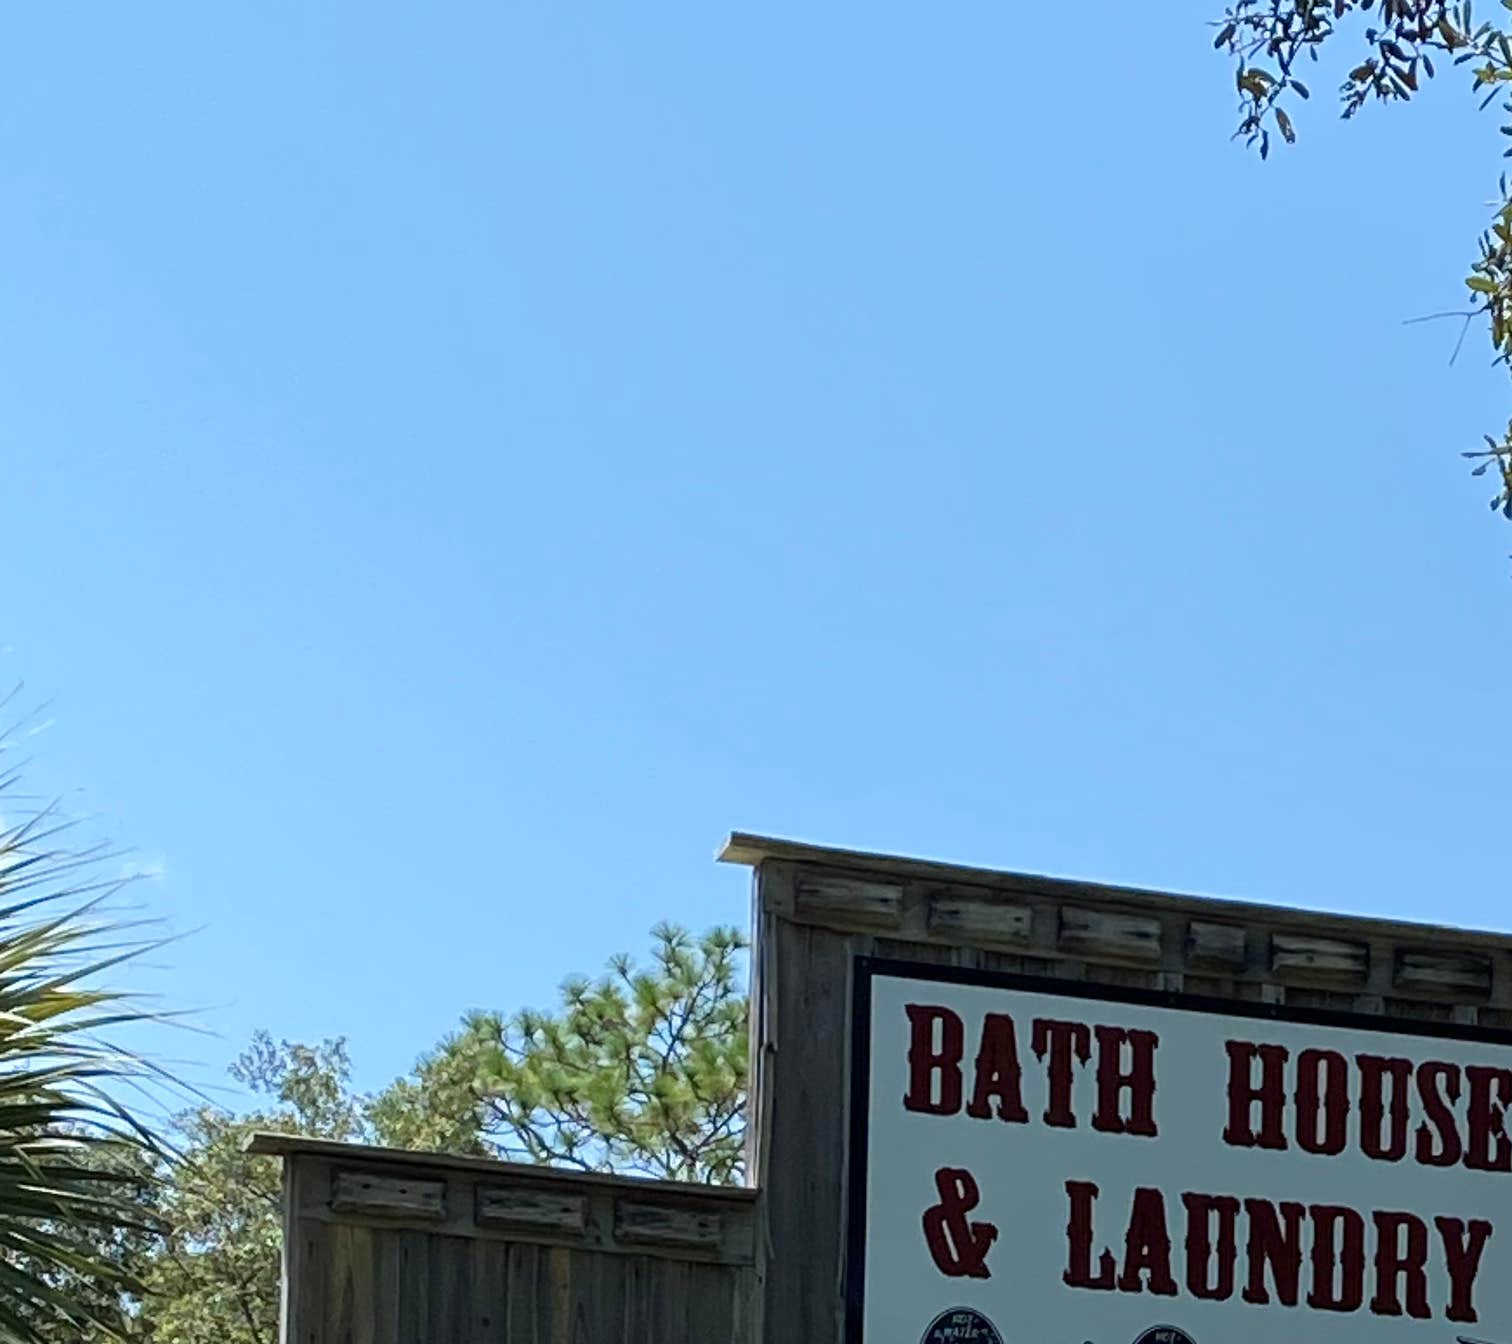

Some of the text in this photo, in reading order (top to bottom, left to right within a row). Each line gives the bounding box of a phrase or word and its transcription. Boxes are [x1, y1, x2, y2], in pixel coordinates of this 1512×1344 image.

[903, 1003, 1160, 1138] BATH
[921, 1166, 1494, 1324] & LAUNDRY
